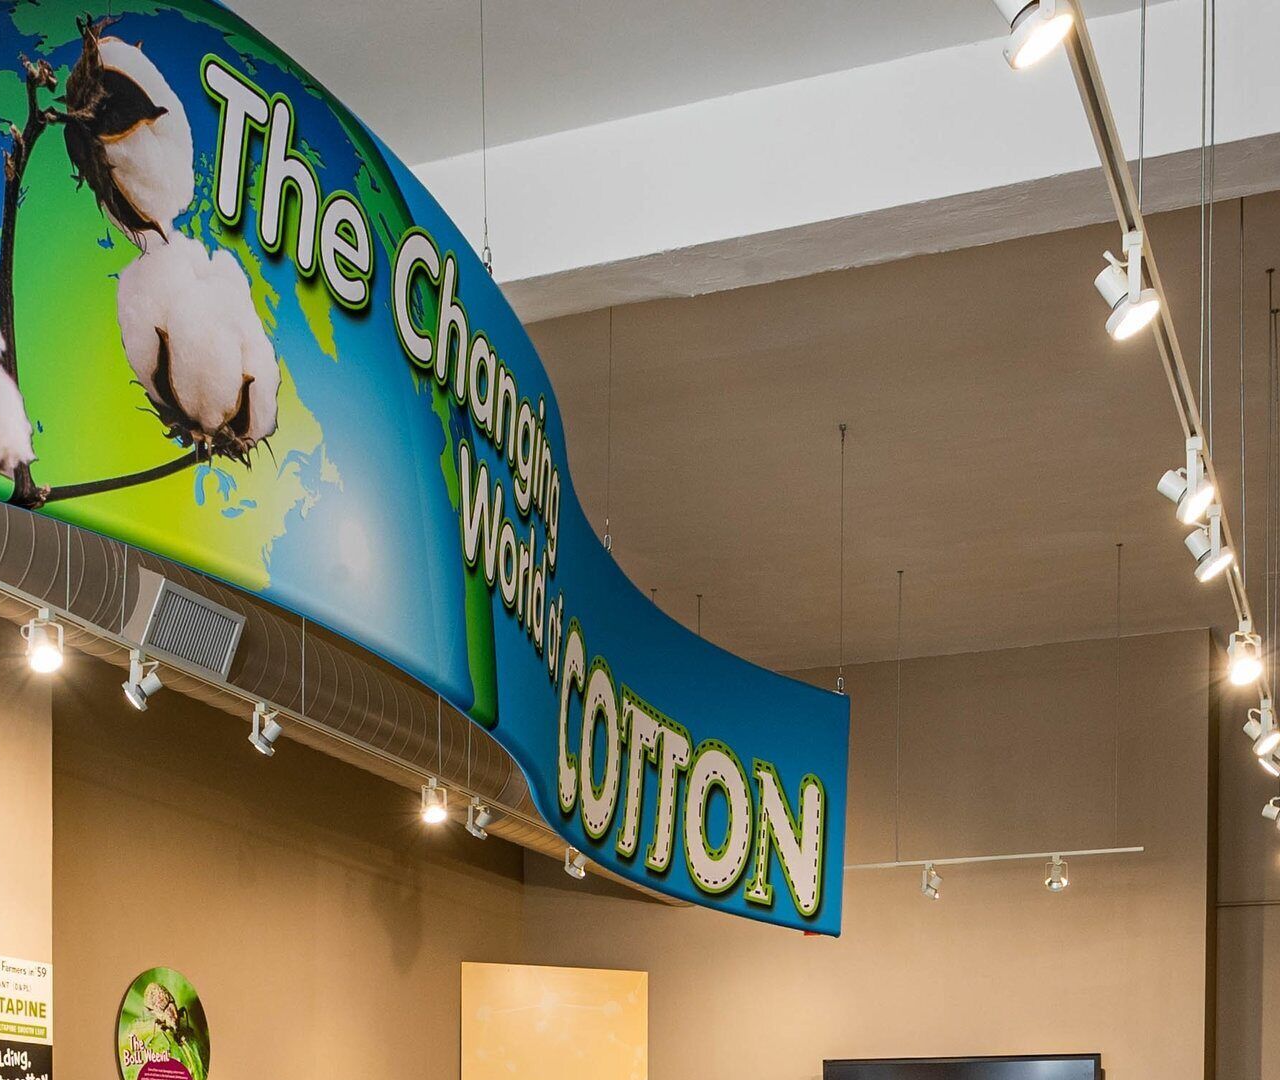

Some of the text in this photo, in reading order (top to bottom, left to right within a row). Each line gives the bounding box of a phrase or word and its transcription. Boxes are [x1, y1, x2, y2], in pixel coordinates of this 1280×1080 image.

[200, 54, 561, 567] The Changing
[457, 438, 563, 684] World of
[558, 617, 825, 917] COTTON
[1, 961, 26, 974] Farmers
[130, 1034, 144, 1050] The
